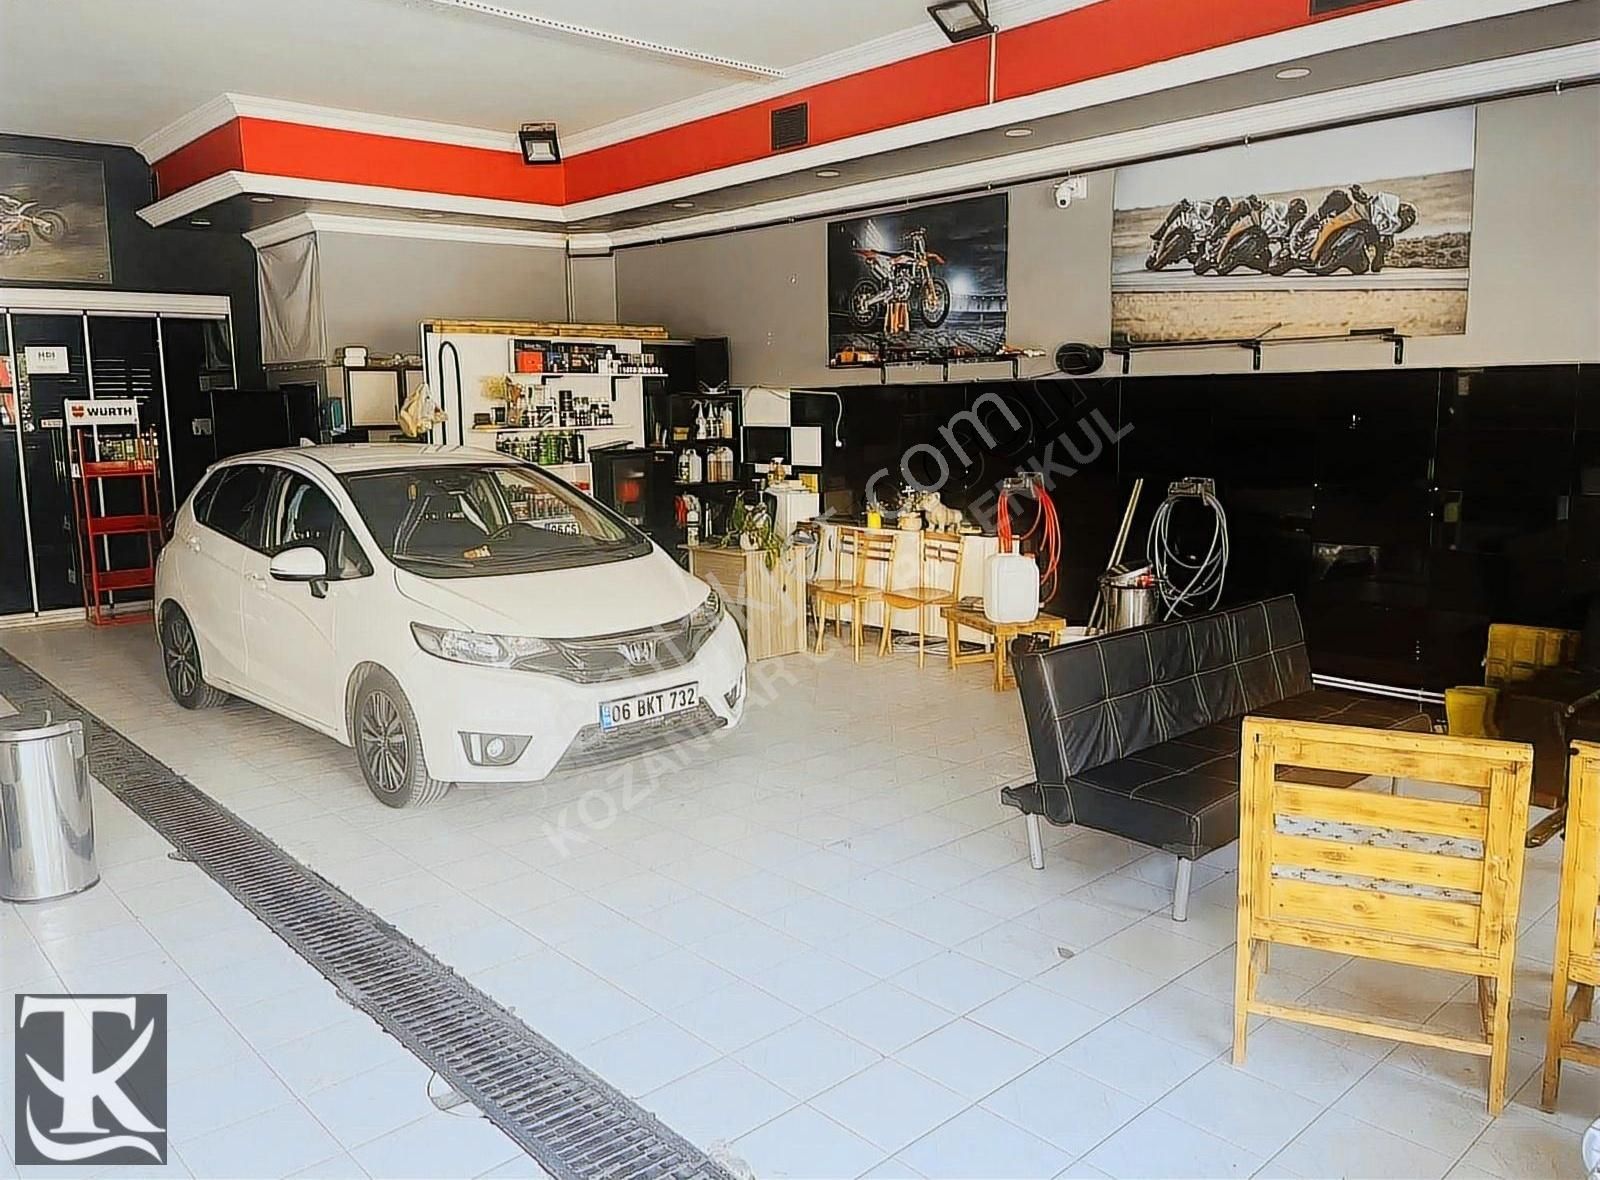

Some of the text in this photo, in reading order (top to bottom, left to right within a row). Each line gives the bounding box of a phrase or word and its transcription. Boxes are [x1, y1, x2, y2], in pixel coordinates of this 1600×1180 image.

[612, 703, 631, 722] 06
[637, 694, 664, 717] BKT
[669, 687, 696, 709] 732
